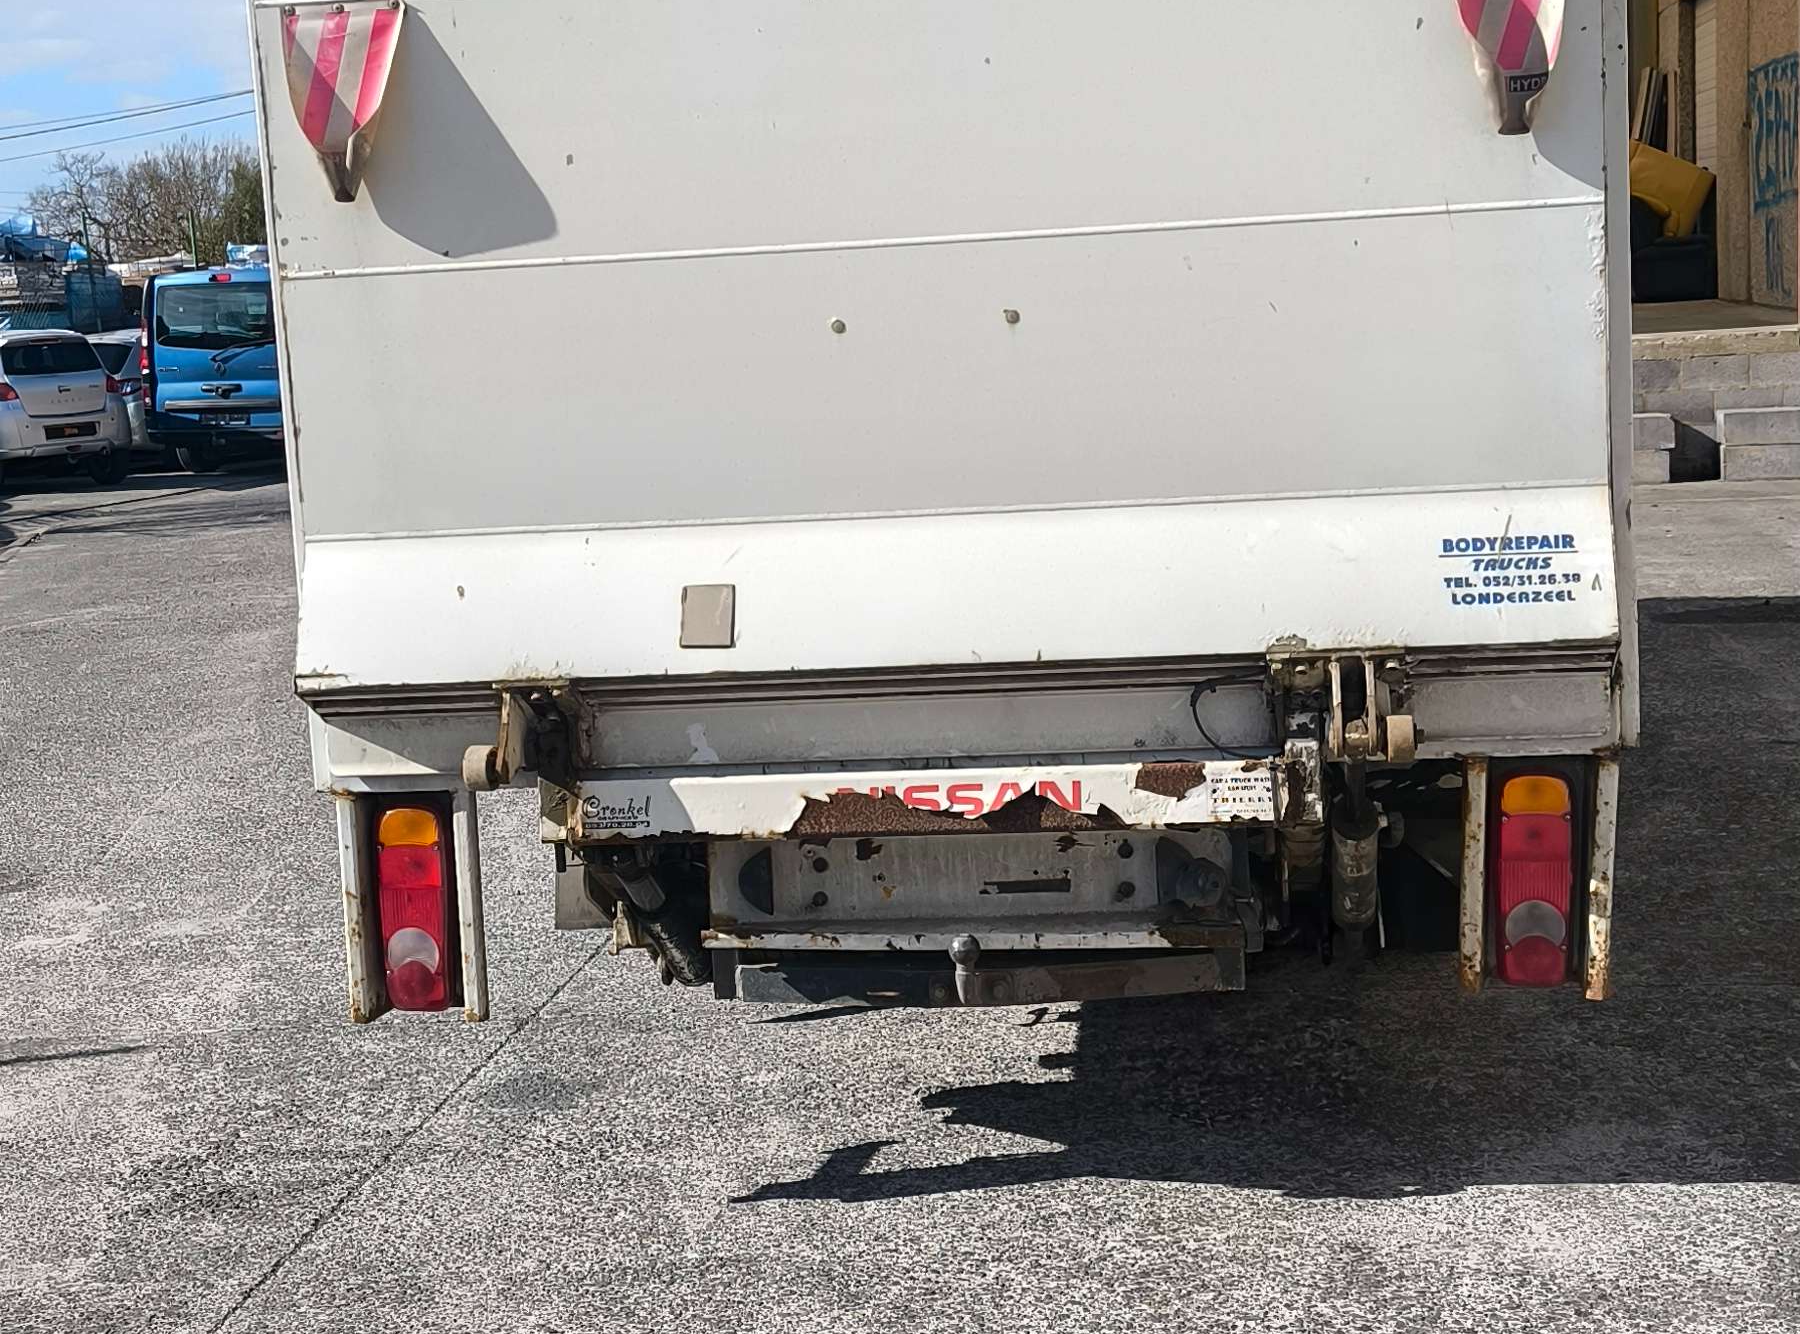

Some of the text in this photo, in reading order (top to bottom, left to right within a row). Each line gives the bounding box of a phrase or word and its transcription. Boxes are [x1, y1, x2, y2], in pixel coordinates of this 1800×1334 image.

[1442, 534, 1576, 553] BODYREPAIR
[1472, 556, 1553, 571] TRUCKS
[1443, 577, 1478, 589] TEL.
[1451, 590, 1576, 605] LONDERZEEL
